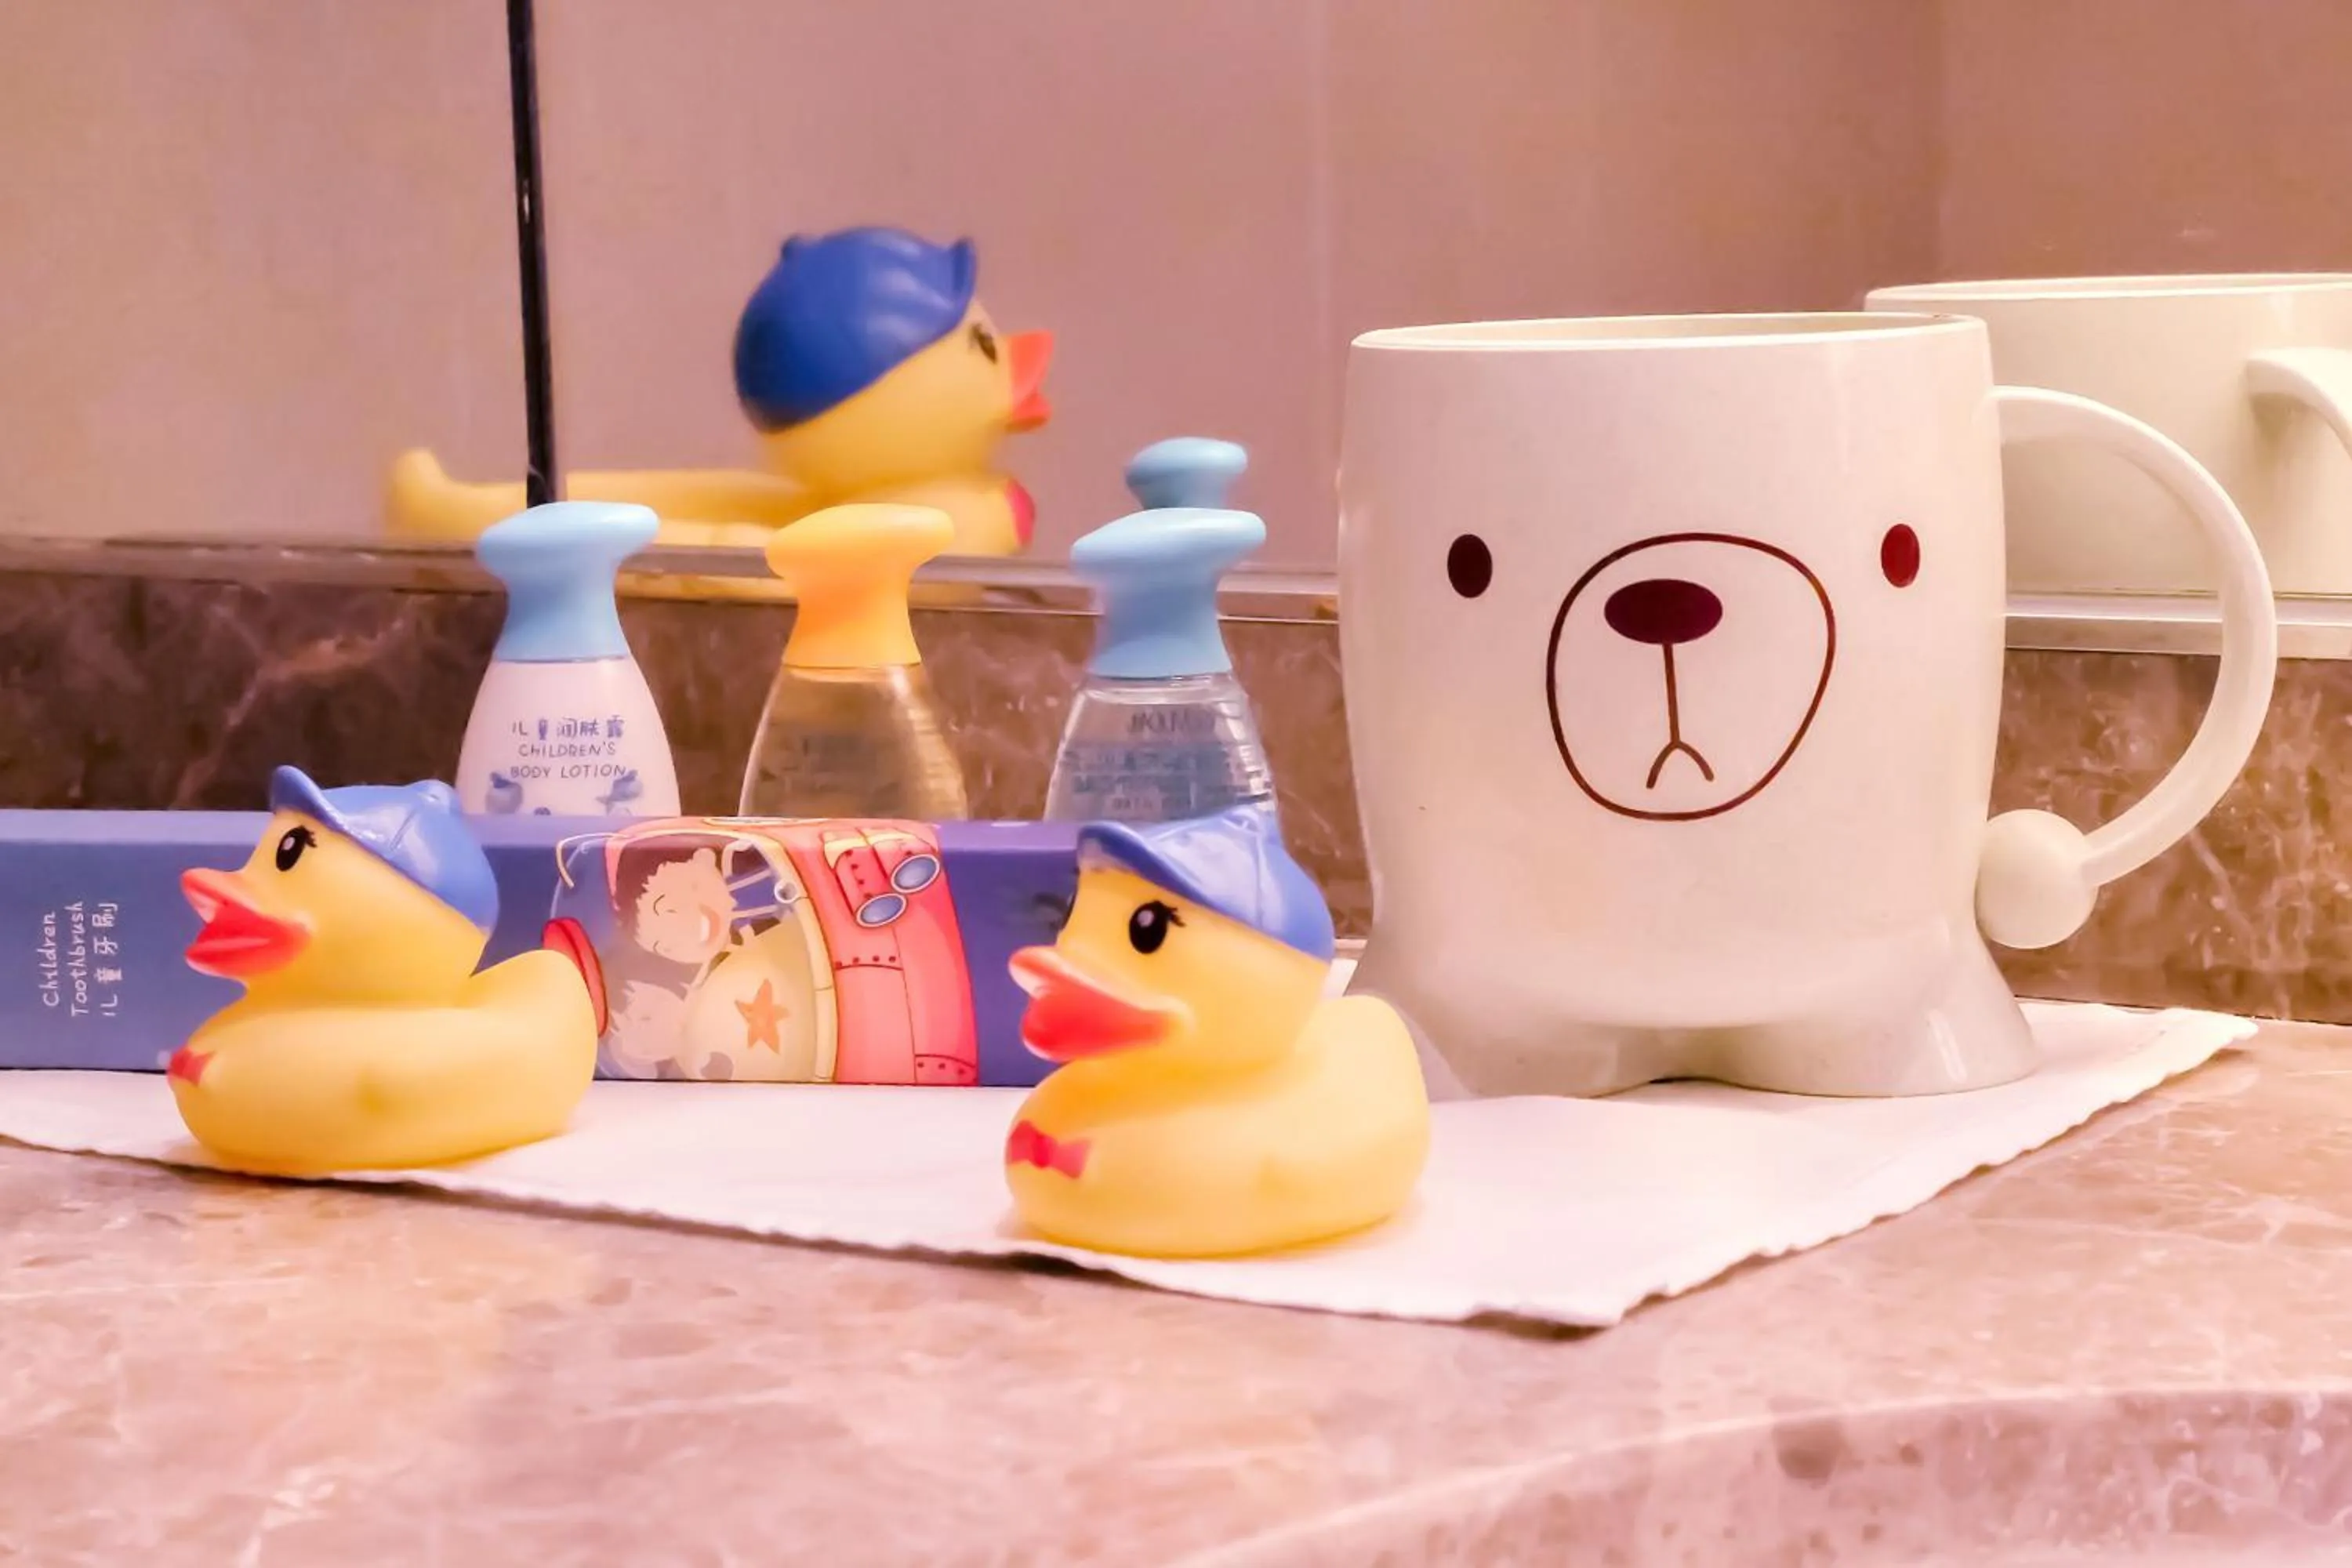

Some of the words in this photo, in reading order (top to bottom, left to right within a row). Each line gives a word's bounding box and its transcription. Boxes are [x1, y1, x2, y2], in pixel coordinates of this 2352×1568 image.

[510, 765, 550, 779] BODY
[561, 764, 626, 779] LOTION
[518, 741, 616, 757] CHILDREN'S
[36, 911, 60, 1007] Children
[64, 901, 89, 1017] Toothbrush
[91, 902, 122, 1017] 儿童牙刷
